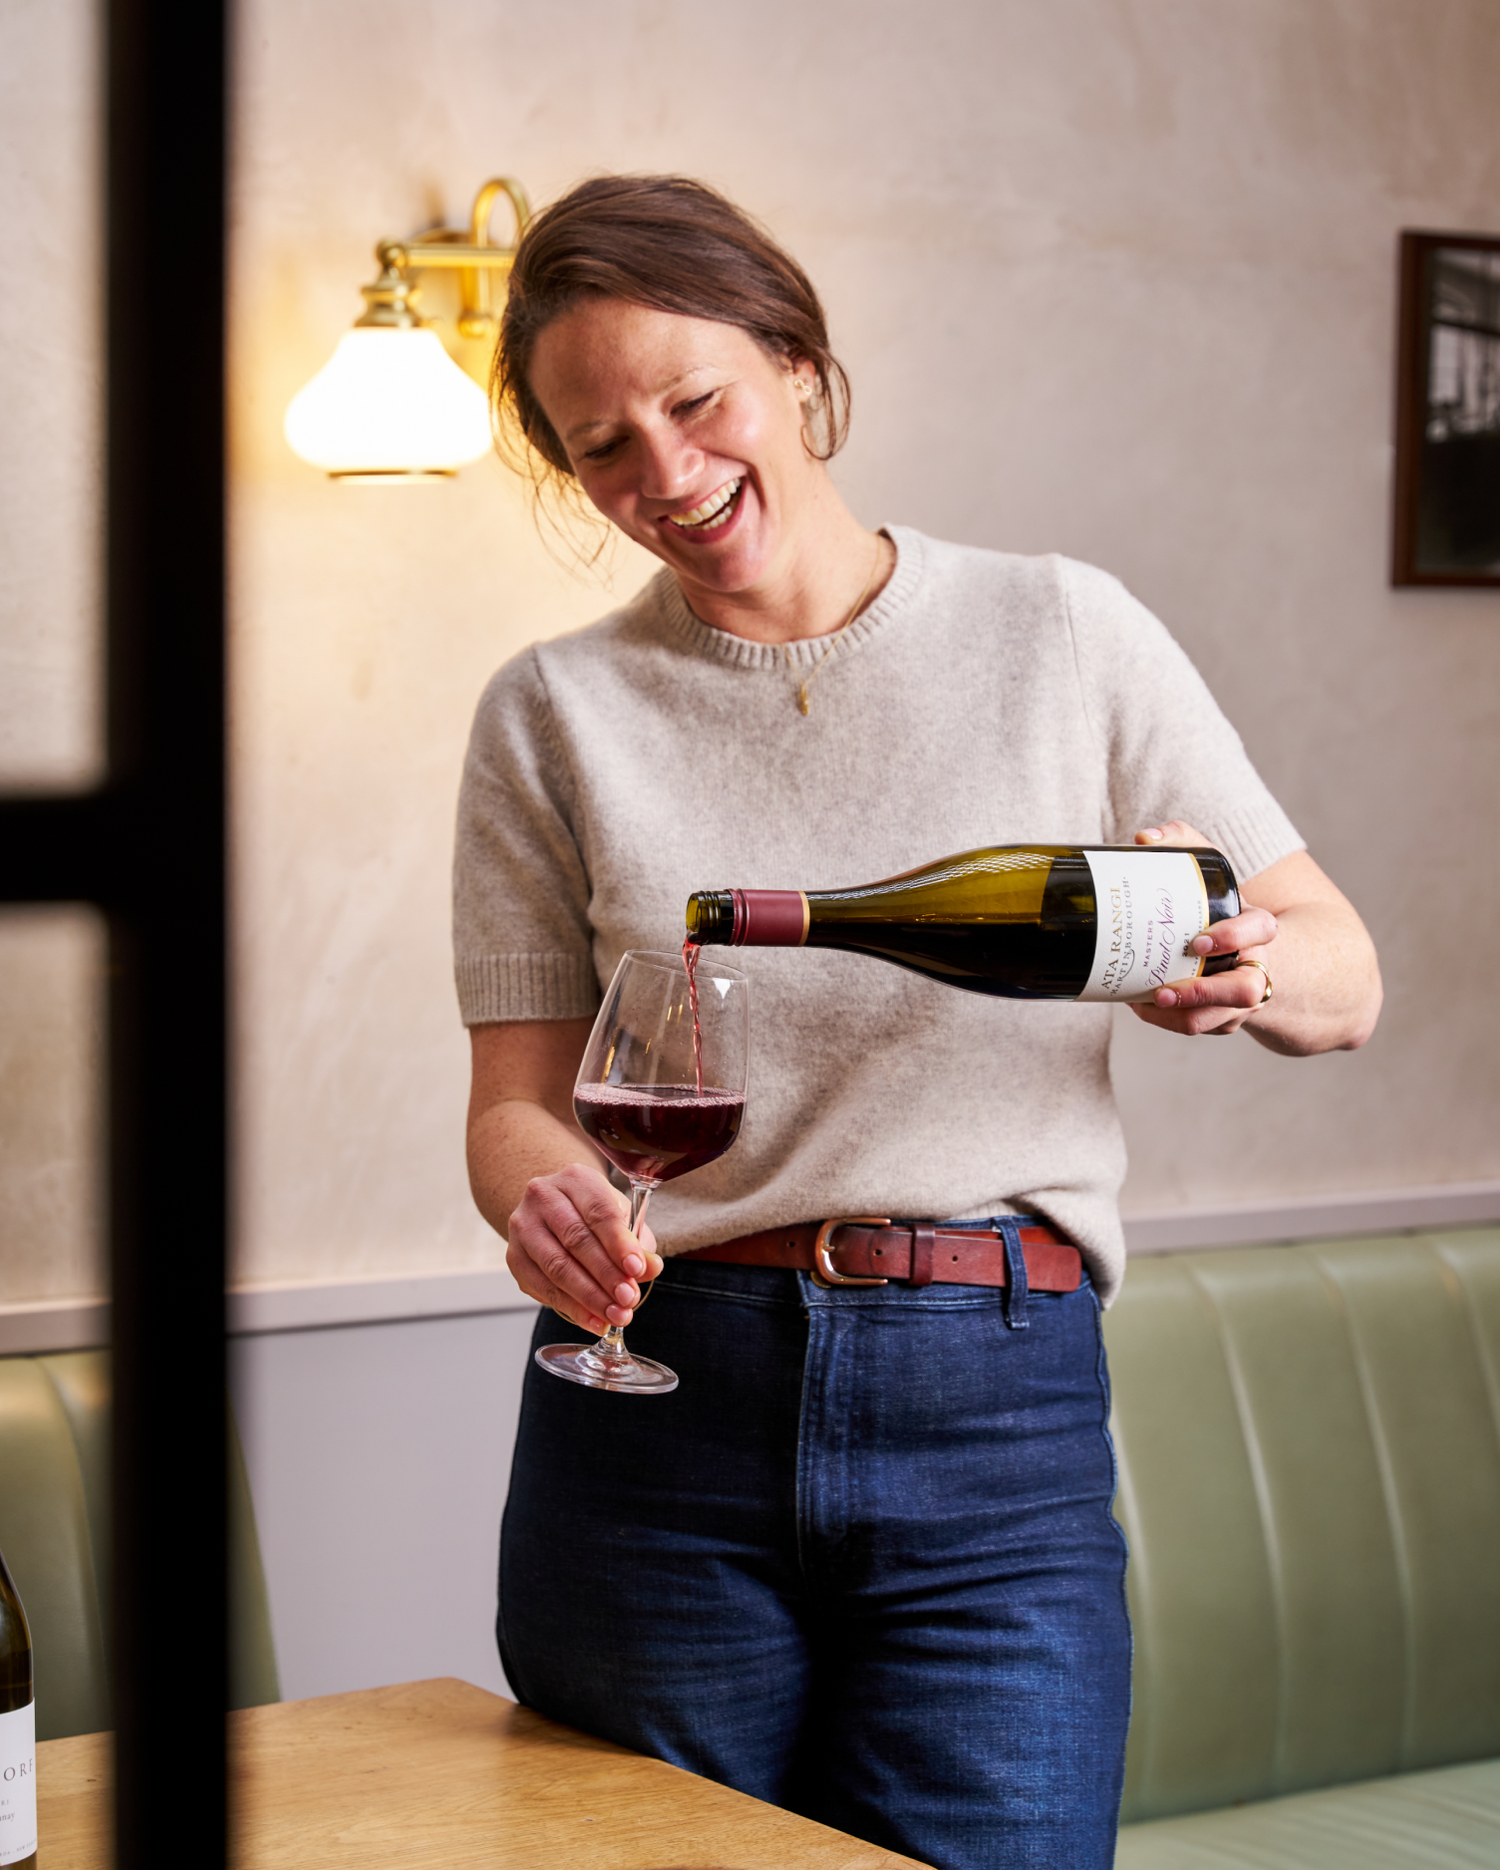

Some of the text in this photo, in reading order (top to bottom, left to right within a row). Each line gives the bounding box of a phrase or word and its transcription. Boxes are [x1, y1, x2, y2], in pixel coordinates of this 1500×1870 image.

[1101, 887, 1123, 990] ATA RANGI
[1110, 879, 1135, 997] MARTINBOROUGH
[1143, 919, 1154, 968] MASTERS
[1145, 887, 1176, 988] Pinot Noir
[1181, 932, 1190, 957] 2021
